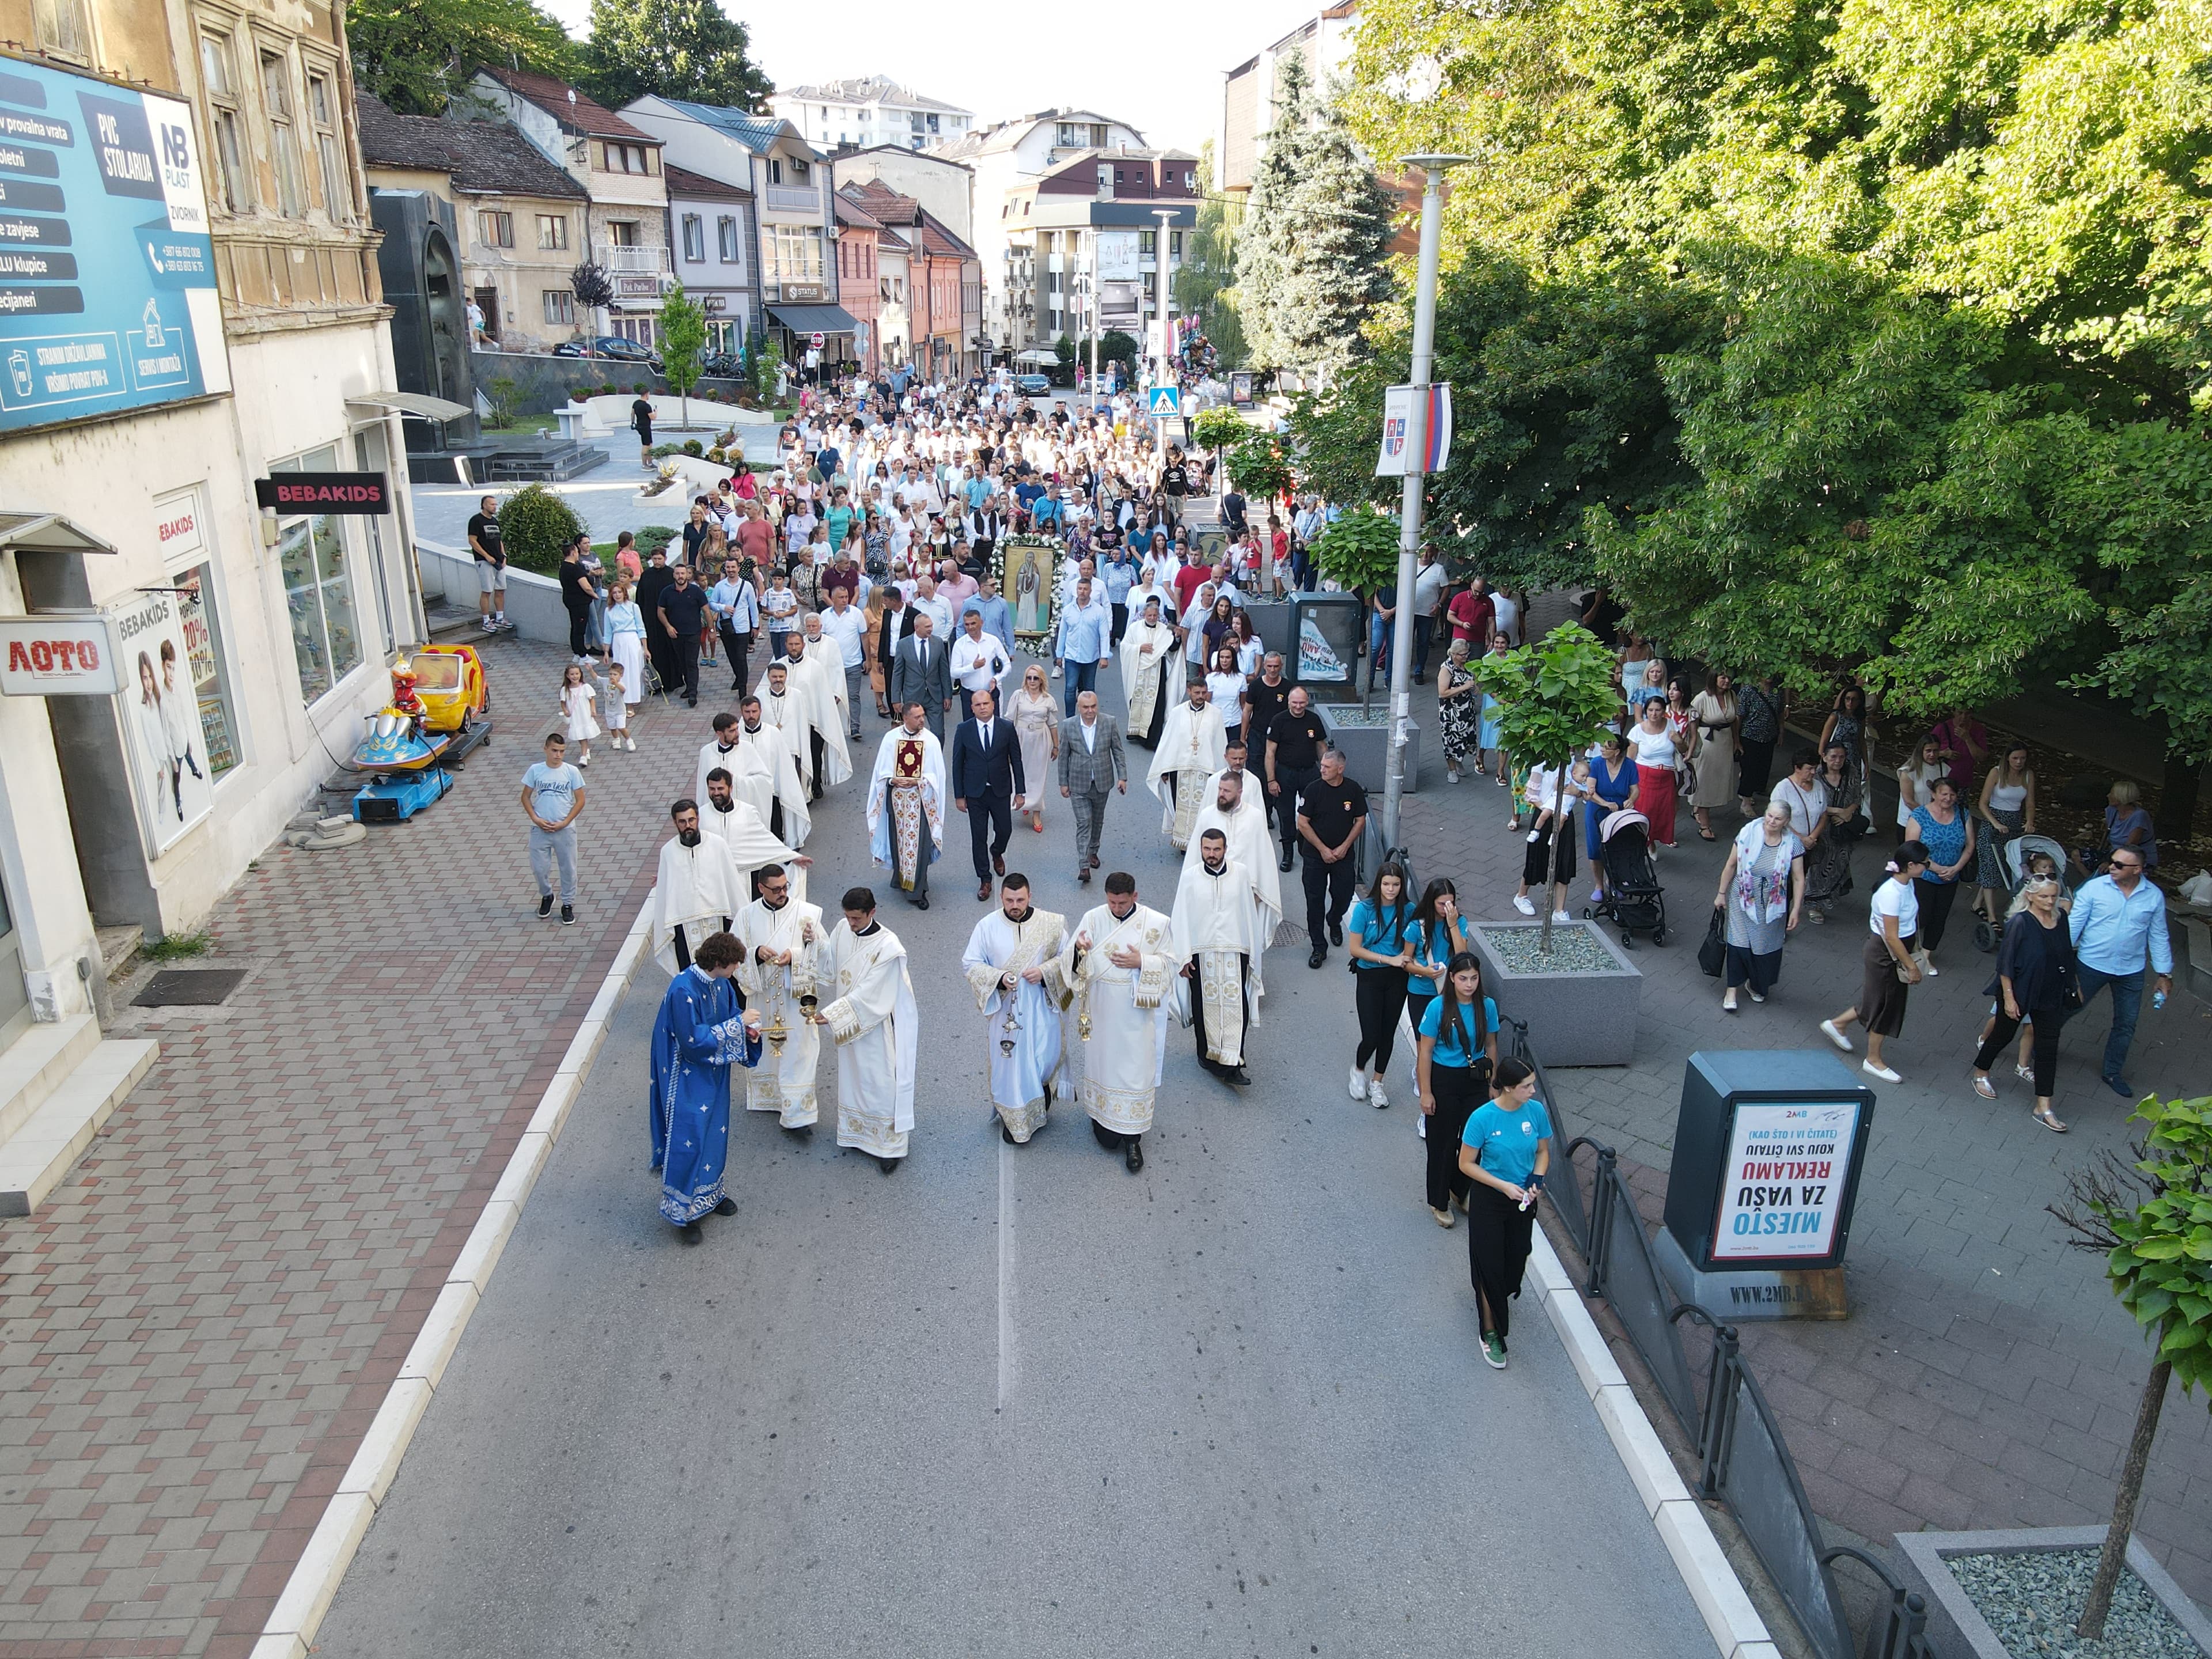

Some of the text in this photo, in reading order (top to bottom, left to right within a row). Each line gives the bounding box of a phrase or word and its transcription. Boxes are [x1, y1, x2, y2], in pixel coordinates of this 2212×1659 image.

[6, 118, 46, 136] provalna
[46, 125, 68, 140] vrata
[97, 113, 119, 145] PVC
[161, 123, 190, 169] NB
[104, 147, 154, 182] STOLARIJA
[166, 168, 190, 189] PLAST
[171, 206, 200, 221] ZVORNIK
[6, 220, 40, 240] zavjese
[14, 256, 47, 276] klupice
[277, 486, 381, 502] BEBAKIDS
[159, 514, 194, 542] EBAKIDS
[119, 600, 169, 641] BEBAKIDS
[183, 616, 208, 652] 20%
[1749, 1128, 1837, 1140] (KAO ŠTO I VI ČITATE)
[1746, 1143, 1834, 1158] KOJU SVI ČITAJU
[1742, 1161, 1831, 1180] REKLAMU
[1737, 1185, 1827, 1212] ZA VAŠU
[1733, 1211, 1821, 1235] MJESTO
